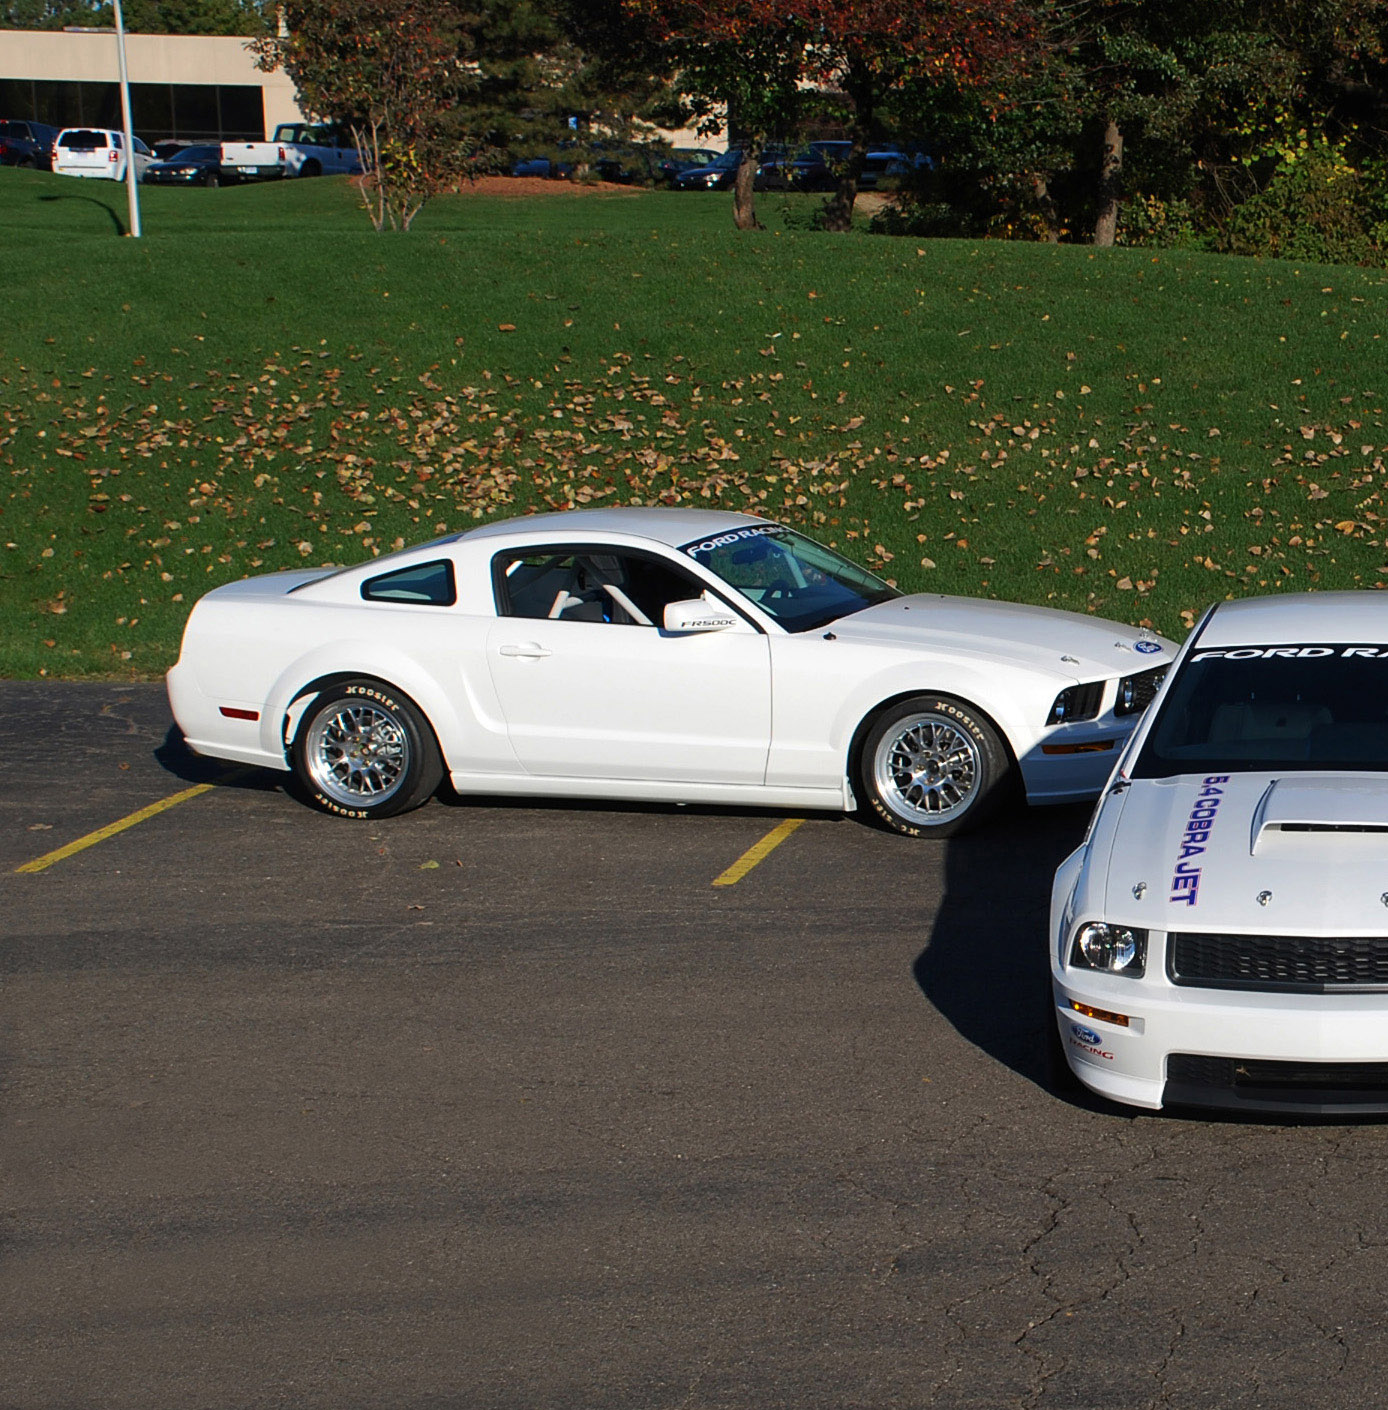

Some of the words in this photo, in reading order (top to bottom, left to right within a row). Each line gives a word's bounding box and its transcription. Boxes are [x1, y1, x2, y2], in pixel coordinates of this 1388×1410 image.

[687, 534, 739, 559] FORD
[681, 619, 737, 628] FR500C
[1190, 647, 1335, 663] FORD
[1198, 775, 1230, 797] 5.4
[1177, 798, 1221, 860] COBRA
[1169, 861, 1202, 907] JET
